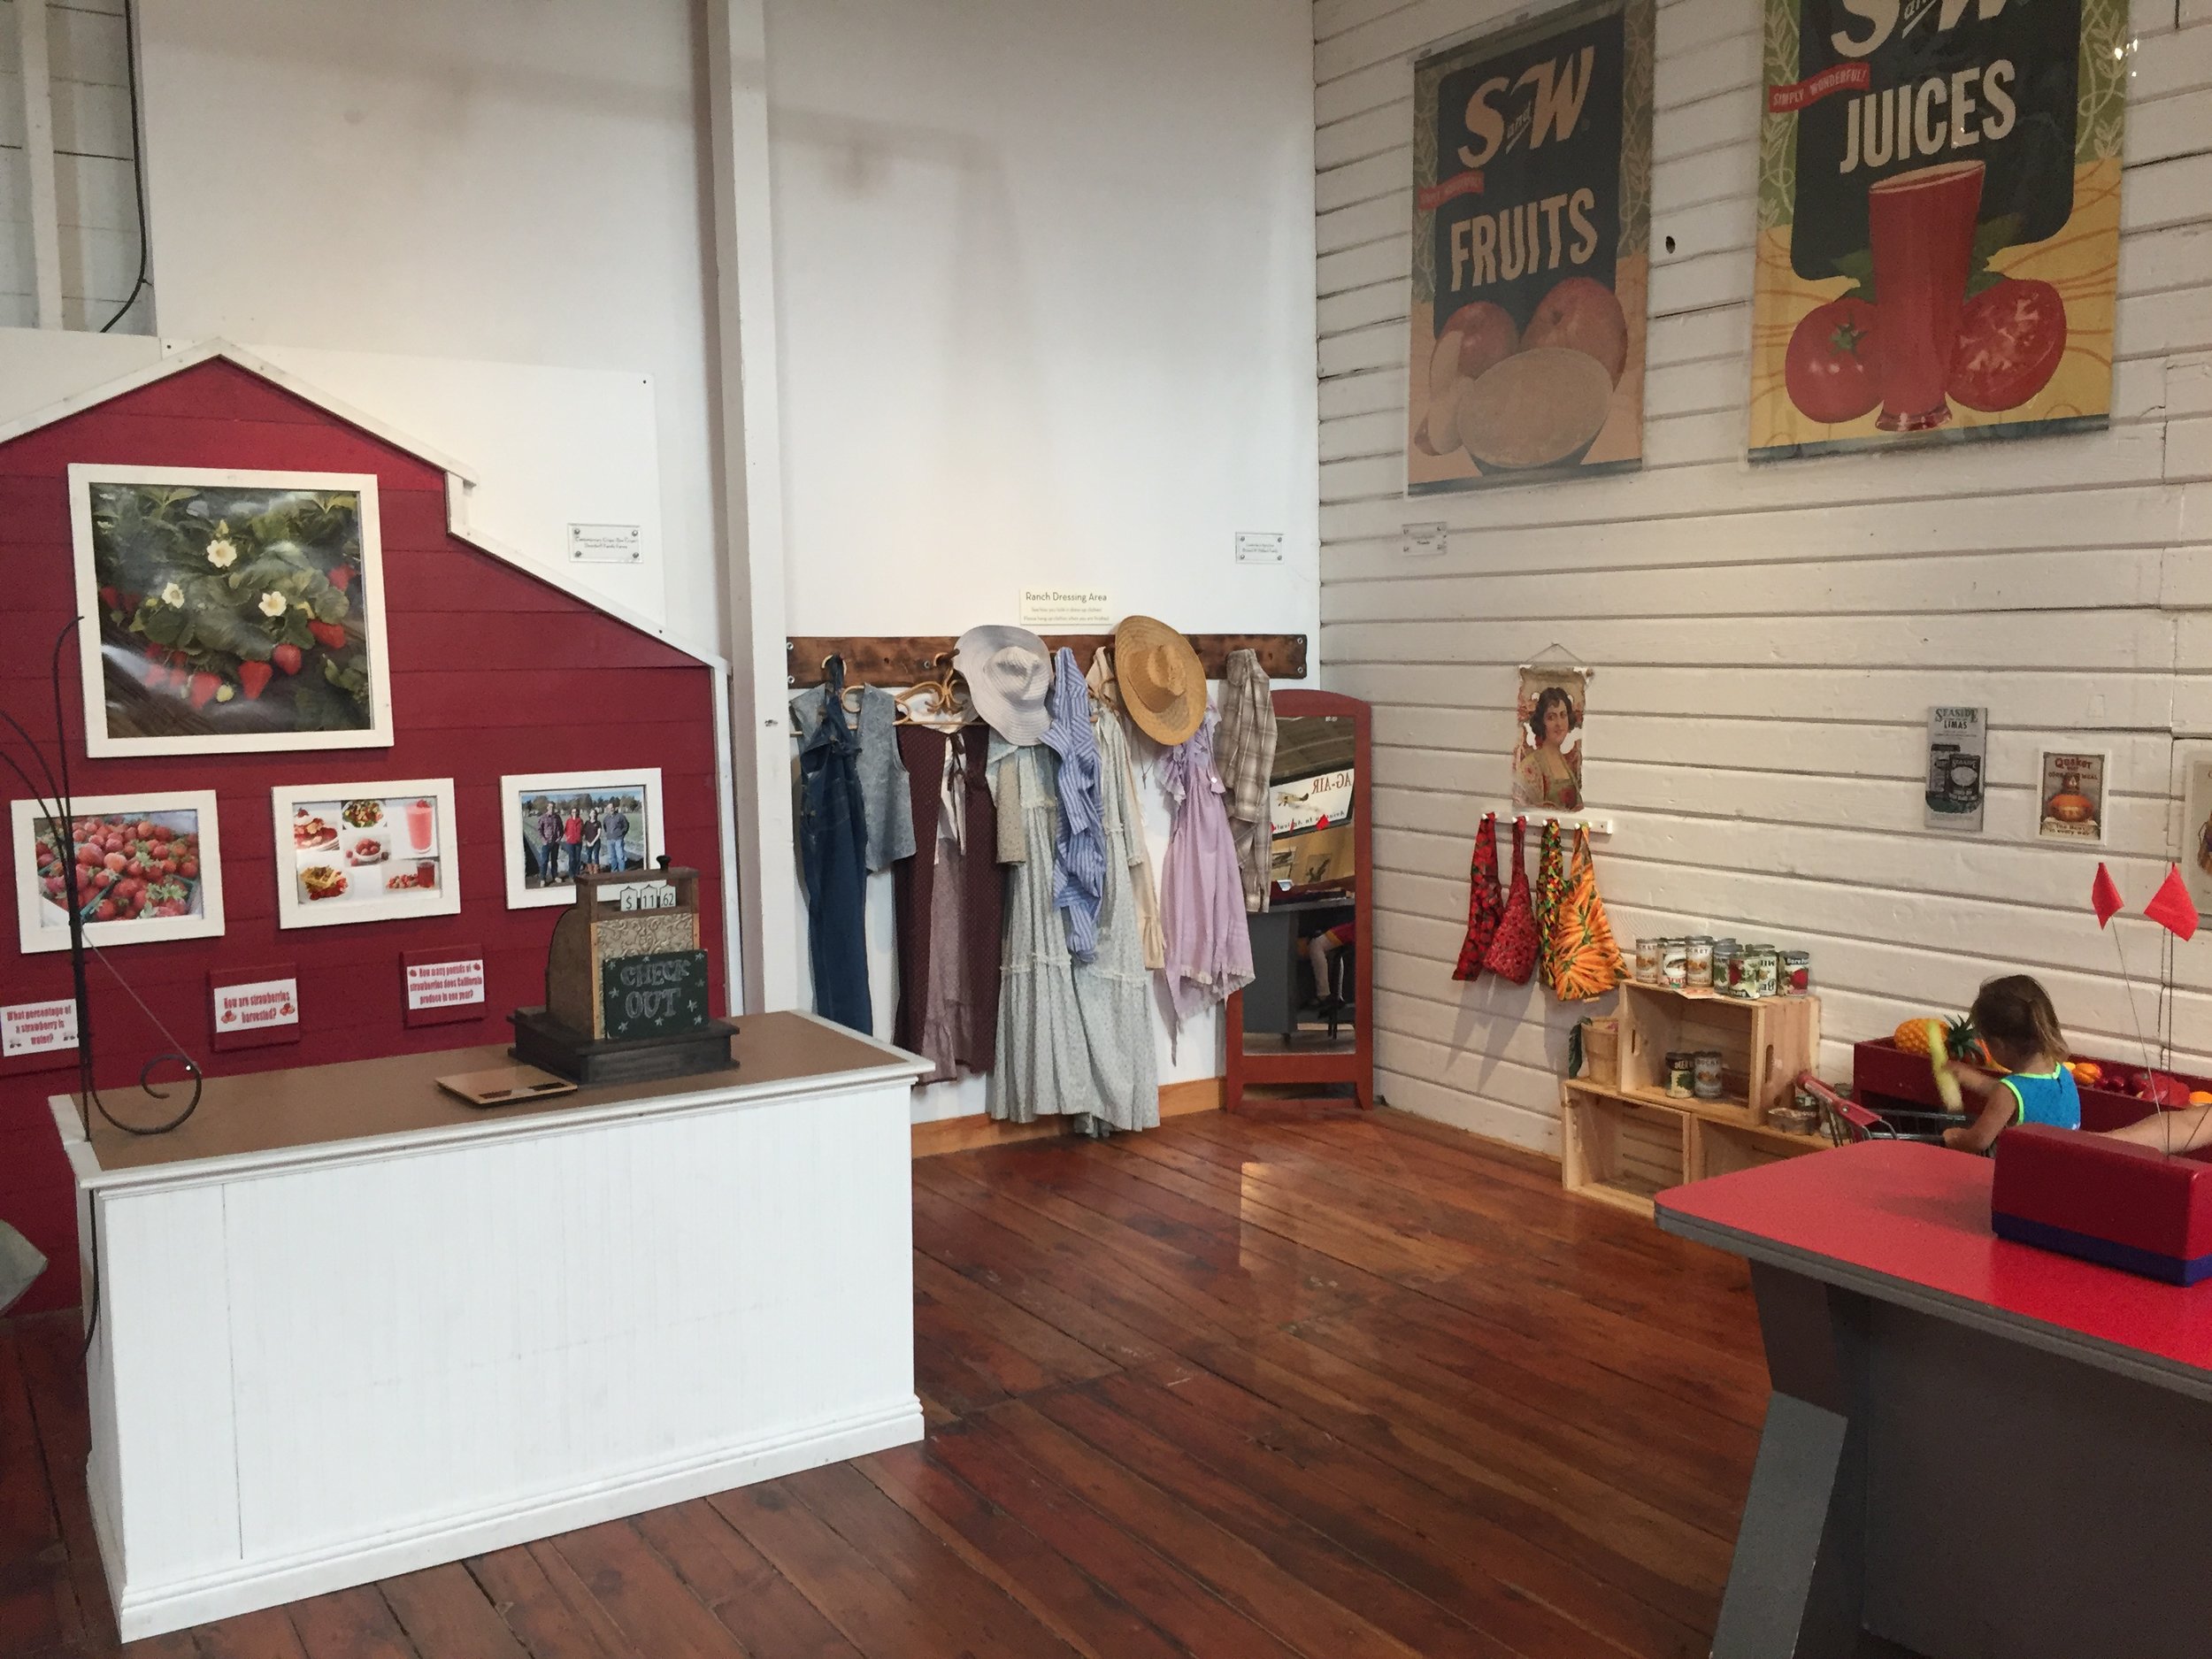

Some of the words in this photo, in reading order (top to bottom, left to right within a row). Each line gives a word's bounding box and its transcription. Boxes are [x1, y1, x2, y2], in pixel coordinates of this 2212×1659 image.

[1773, 88, 1804, 105] SIMPLY
[1809, 68, 1867, 96] WONDERFUL!
[1839, 58, 2016, 174] JUICES
[1450, 188, 1598, 292] FRUITS
[1025, 591, 1051, 602] Ranch
[1052, 591, 1087, 603] Dressing
[1088, 592, 1108, 602] Area
[1935, 708, 1978, 723] SEASIDE
[1944, 720, 1968, 730] LIMAS
[626, 895, 633, 910] $
[642, 895, 655, 909] 11
[419, 968, 430, 978] How
[432, 966, 445, 977] many
[446, 964, 465, 976] pounds
[466, 963, 472, 973] of
[620, 959, 692, 987] CHECK
[410, 979, 442, 991] strawberries
[443, 979, 457, 988] does
[457, 976, 482, 987] California
[224, 997, 237, 1009] How
[239, 996, 249, 1007] are
[250, 990, 290, 1006] strawberries
[420, 993, 442, 1005] produce
[442, 992, 448, 1002] in
[449, 991, 457, 1001] one
[459, 988, 473, 1001] year?
[625, 987, 681, 1018] OUT
[7, 1010, 25, 1021] What
[26, 1007, 63, 1019] percentage
[65, 1004, 72, 1015] of
[242, 1007, 277, 1024] harvested?
[21, 1020, 58, 1033] strawberry
[58, 1018, 65, 1028] is
[31, 1033, 54, 1045] water?
